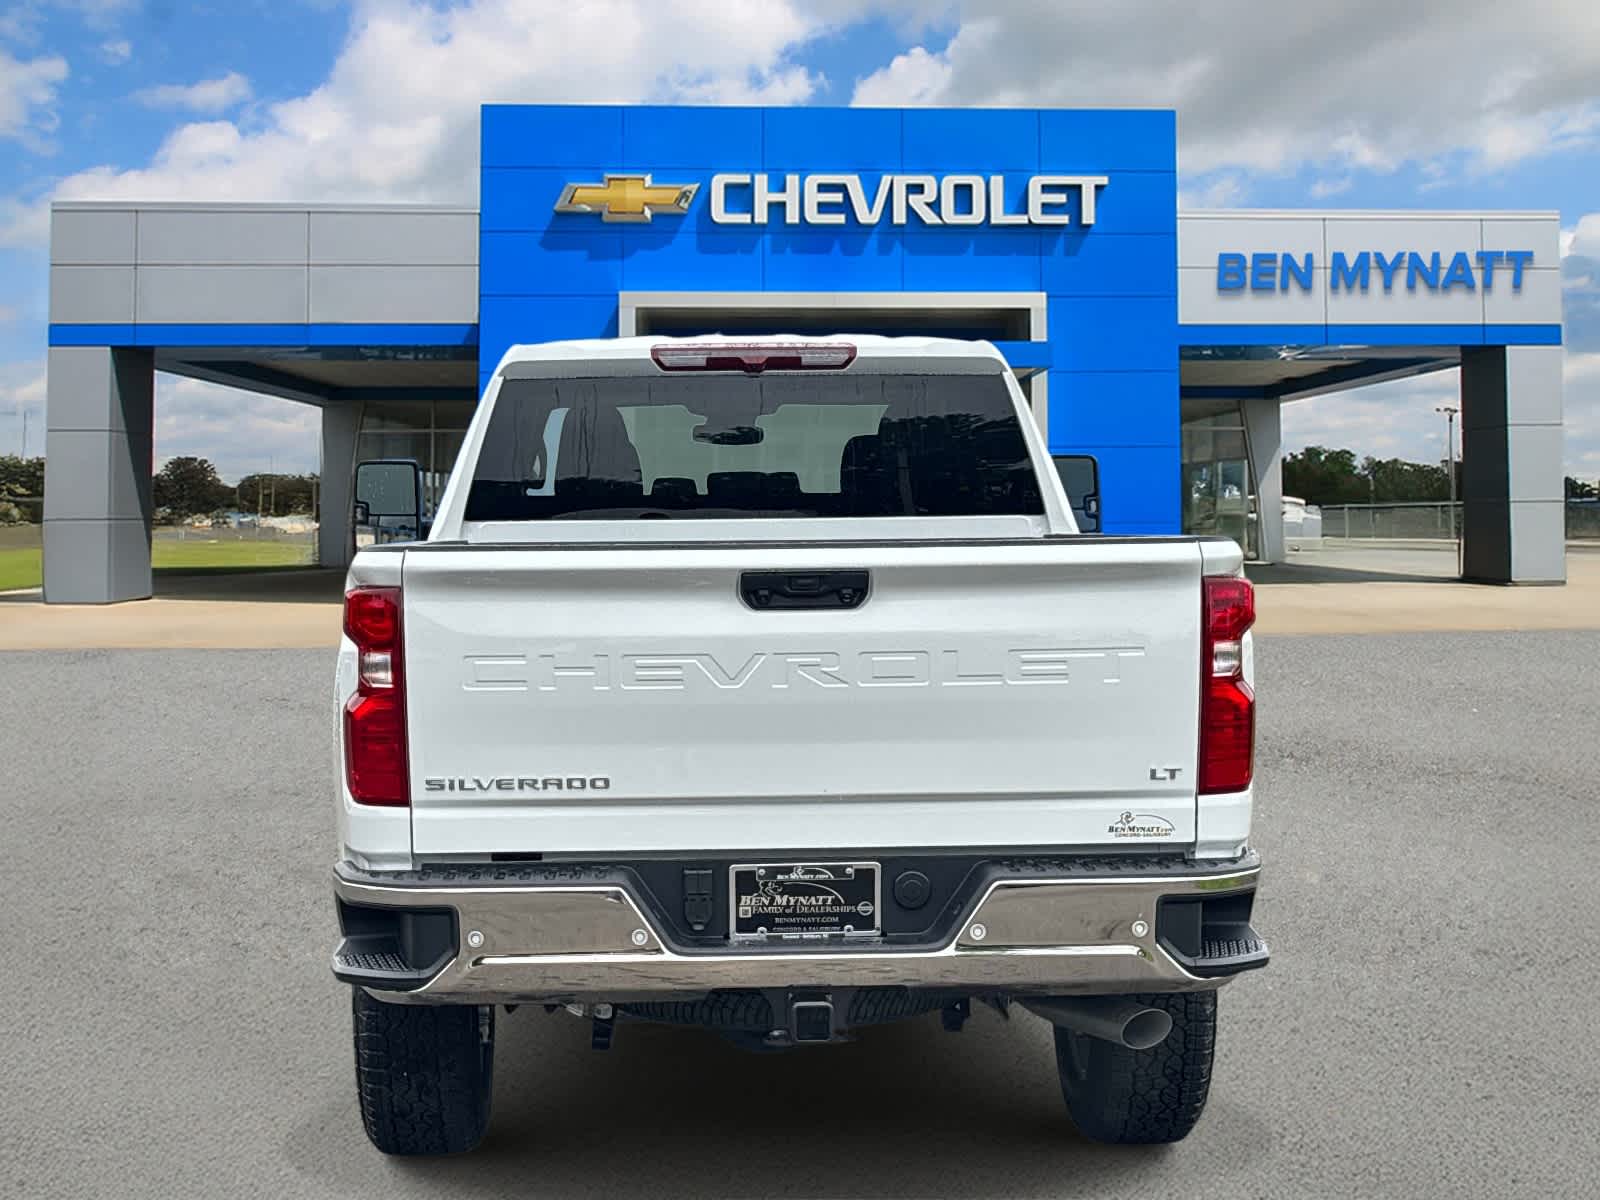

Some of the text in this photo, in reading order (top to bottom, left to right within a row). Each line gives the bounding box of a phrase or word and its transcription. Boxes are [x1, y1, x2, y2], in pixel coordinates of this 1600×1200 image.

[711, 174, 1109, 225] CHEVROLET
[1217, 251, 1534, 290] BEN MYNATT
[462, 647, 1145, 692] CHEVROLET
[1150, 768, 1182, 780] LT
[425, 777, 610, 791] SILVERADO
[739, 894, 835, 906] BEN MYNATT
[752, 906, 783, 914] FAMILY
[796, 905, 857, 913] DEALERSHIPS
